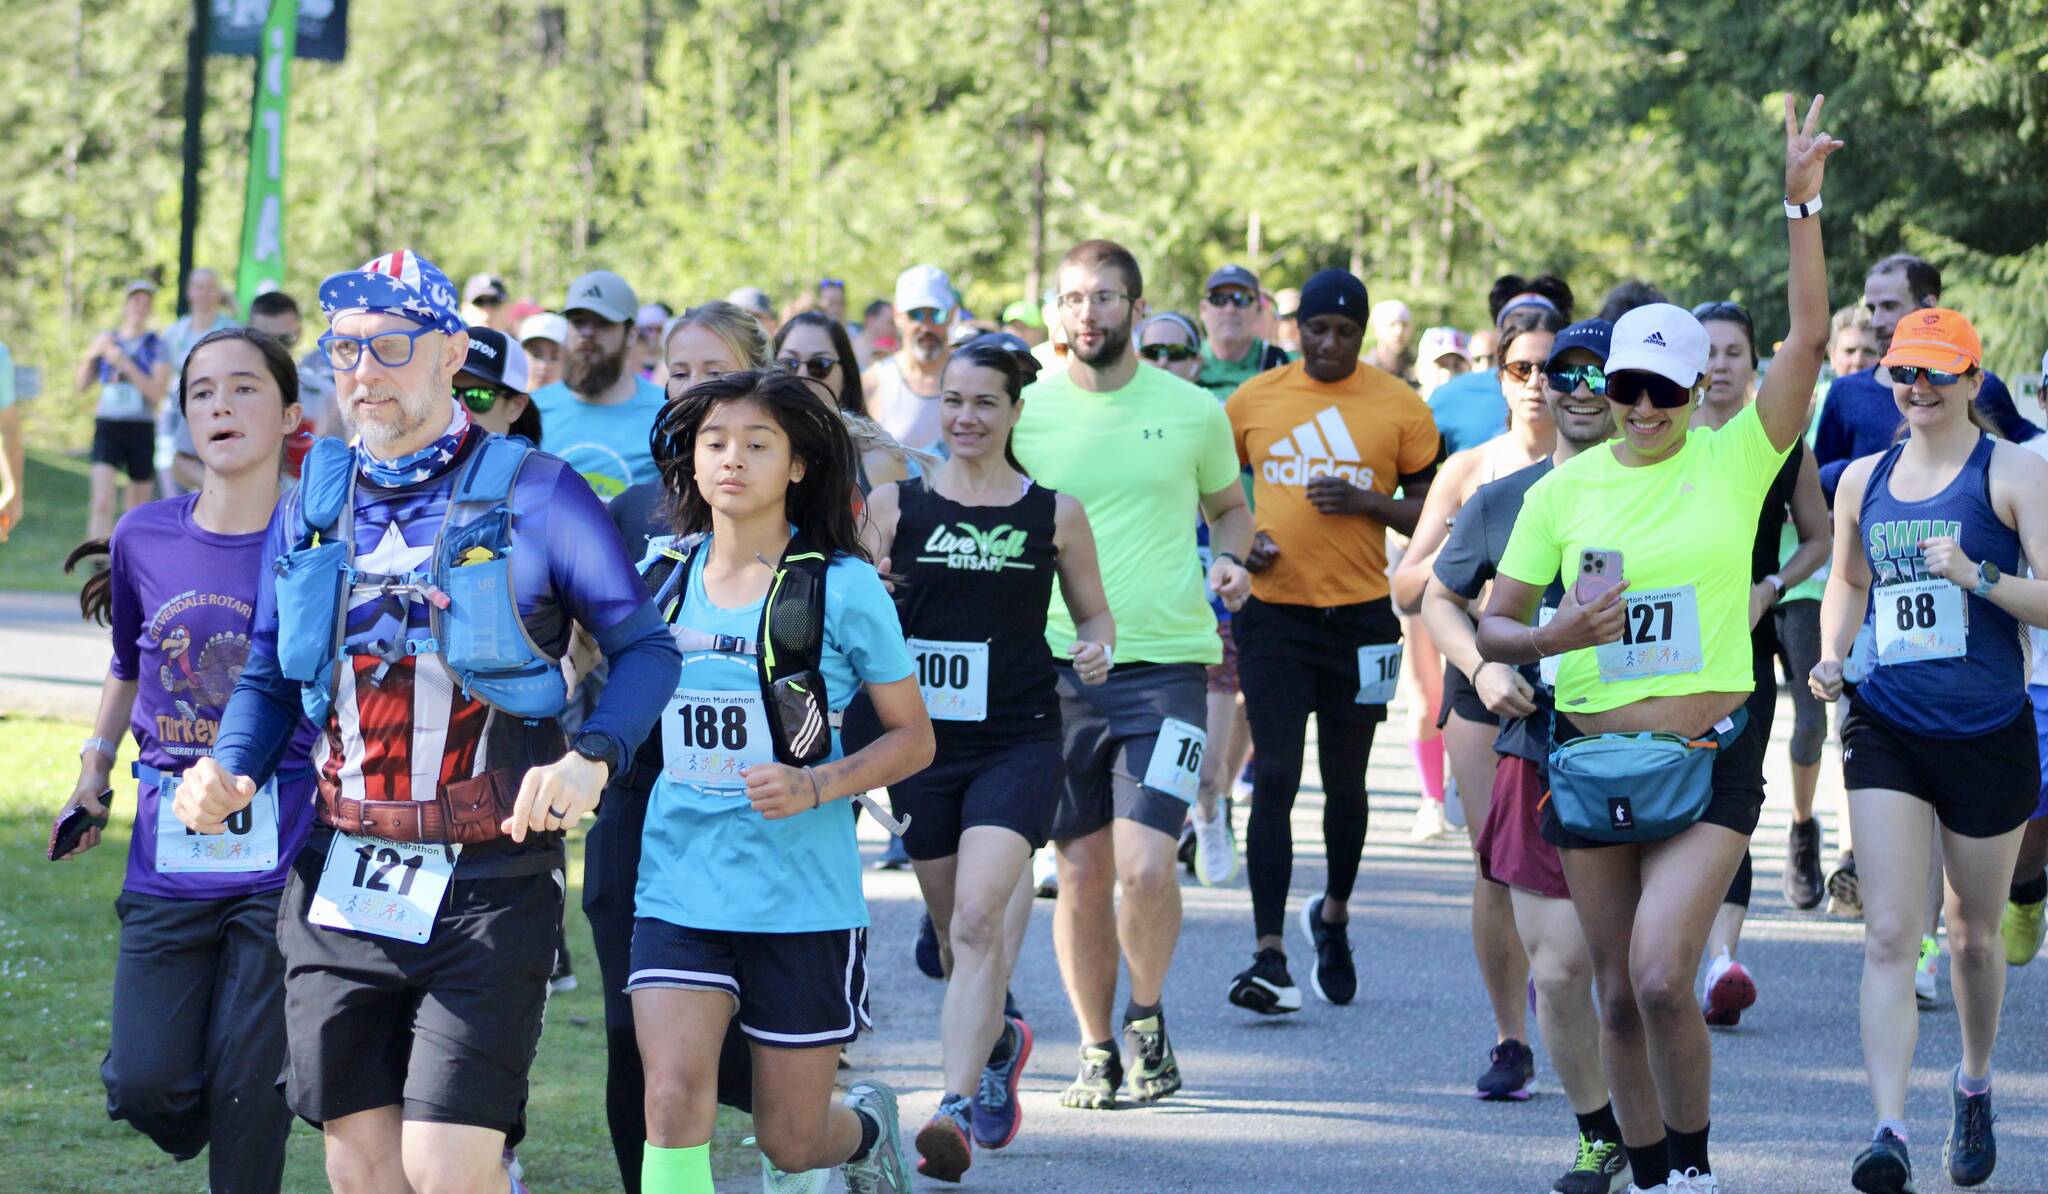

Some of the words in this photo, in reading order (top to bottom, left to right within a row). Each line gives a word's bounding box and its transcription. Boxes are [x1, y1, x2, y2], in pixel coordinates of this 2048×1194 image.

[1263, 454, 1375, 491] adidas
[947, 553, 999, 571] KITSAP
[1644, 592, 1682, 602] Marathon
[1915, 584, 1949, 592] Marathon
[152, 595, 208, 642] SILVERDALE
[1623, 601, 1674, 646] 127
[1896, 593, 1937, 631] 88
[916, 652, 969, 690] 100
[678, 704, 748, 751] 188
[353, 844, 423, 896] 121
